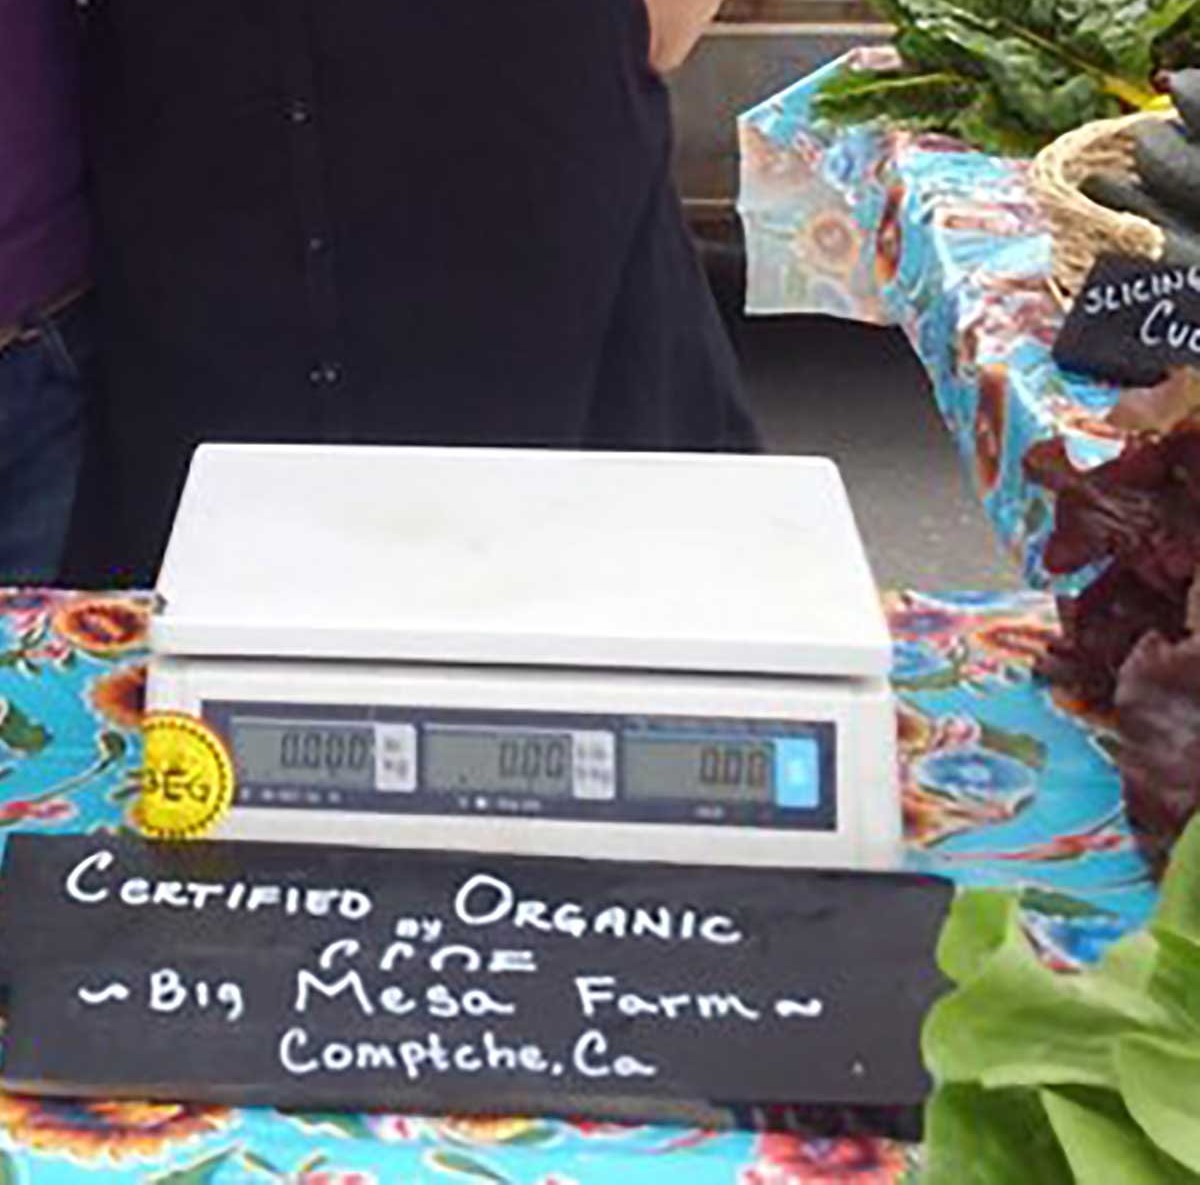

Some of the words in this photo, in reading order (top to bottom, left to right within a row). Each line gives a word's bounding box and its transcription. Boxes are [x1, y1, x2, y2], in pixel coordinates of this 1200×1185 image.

[454, 874, 743, 945] ORGANIC
[150, 968, 243, 1021] Big
[294, 969, 515, 1018] Mesa
[574, 976, 760, 1020] Farm
